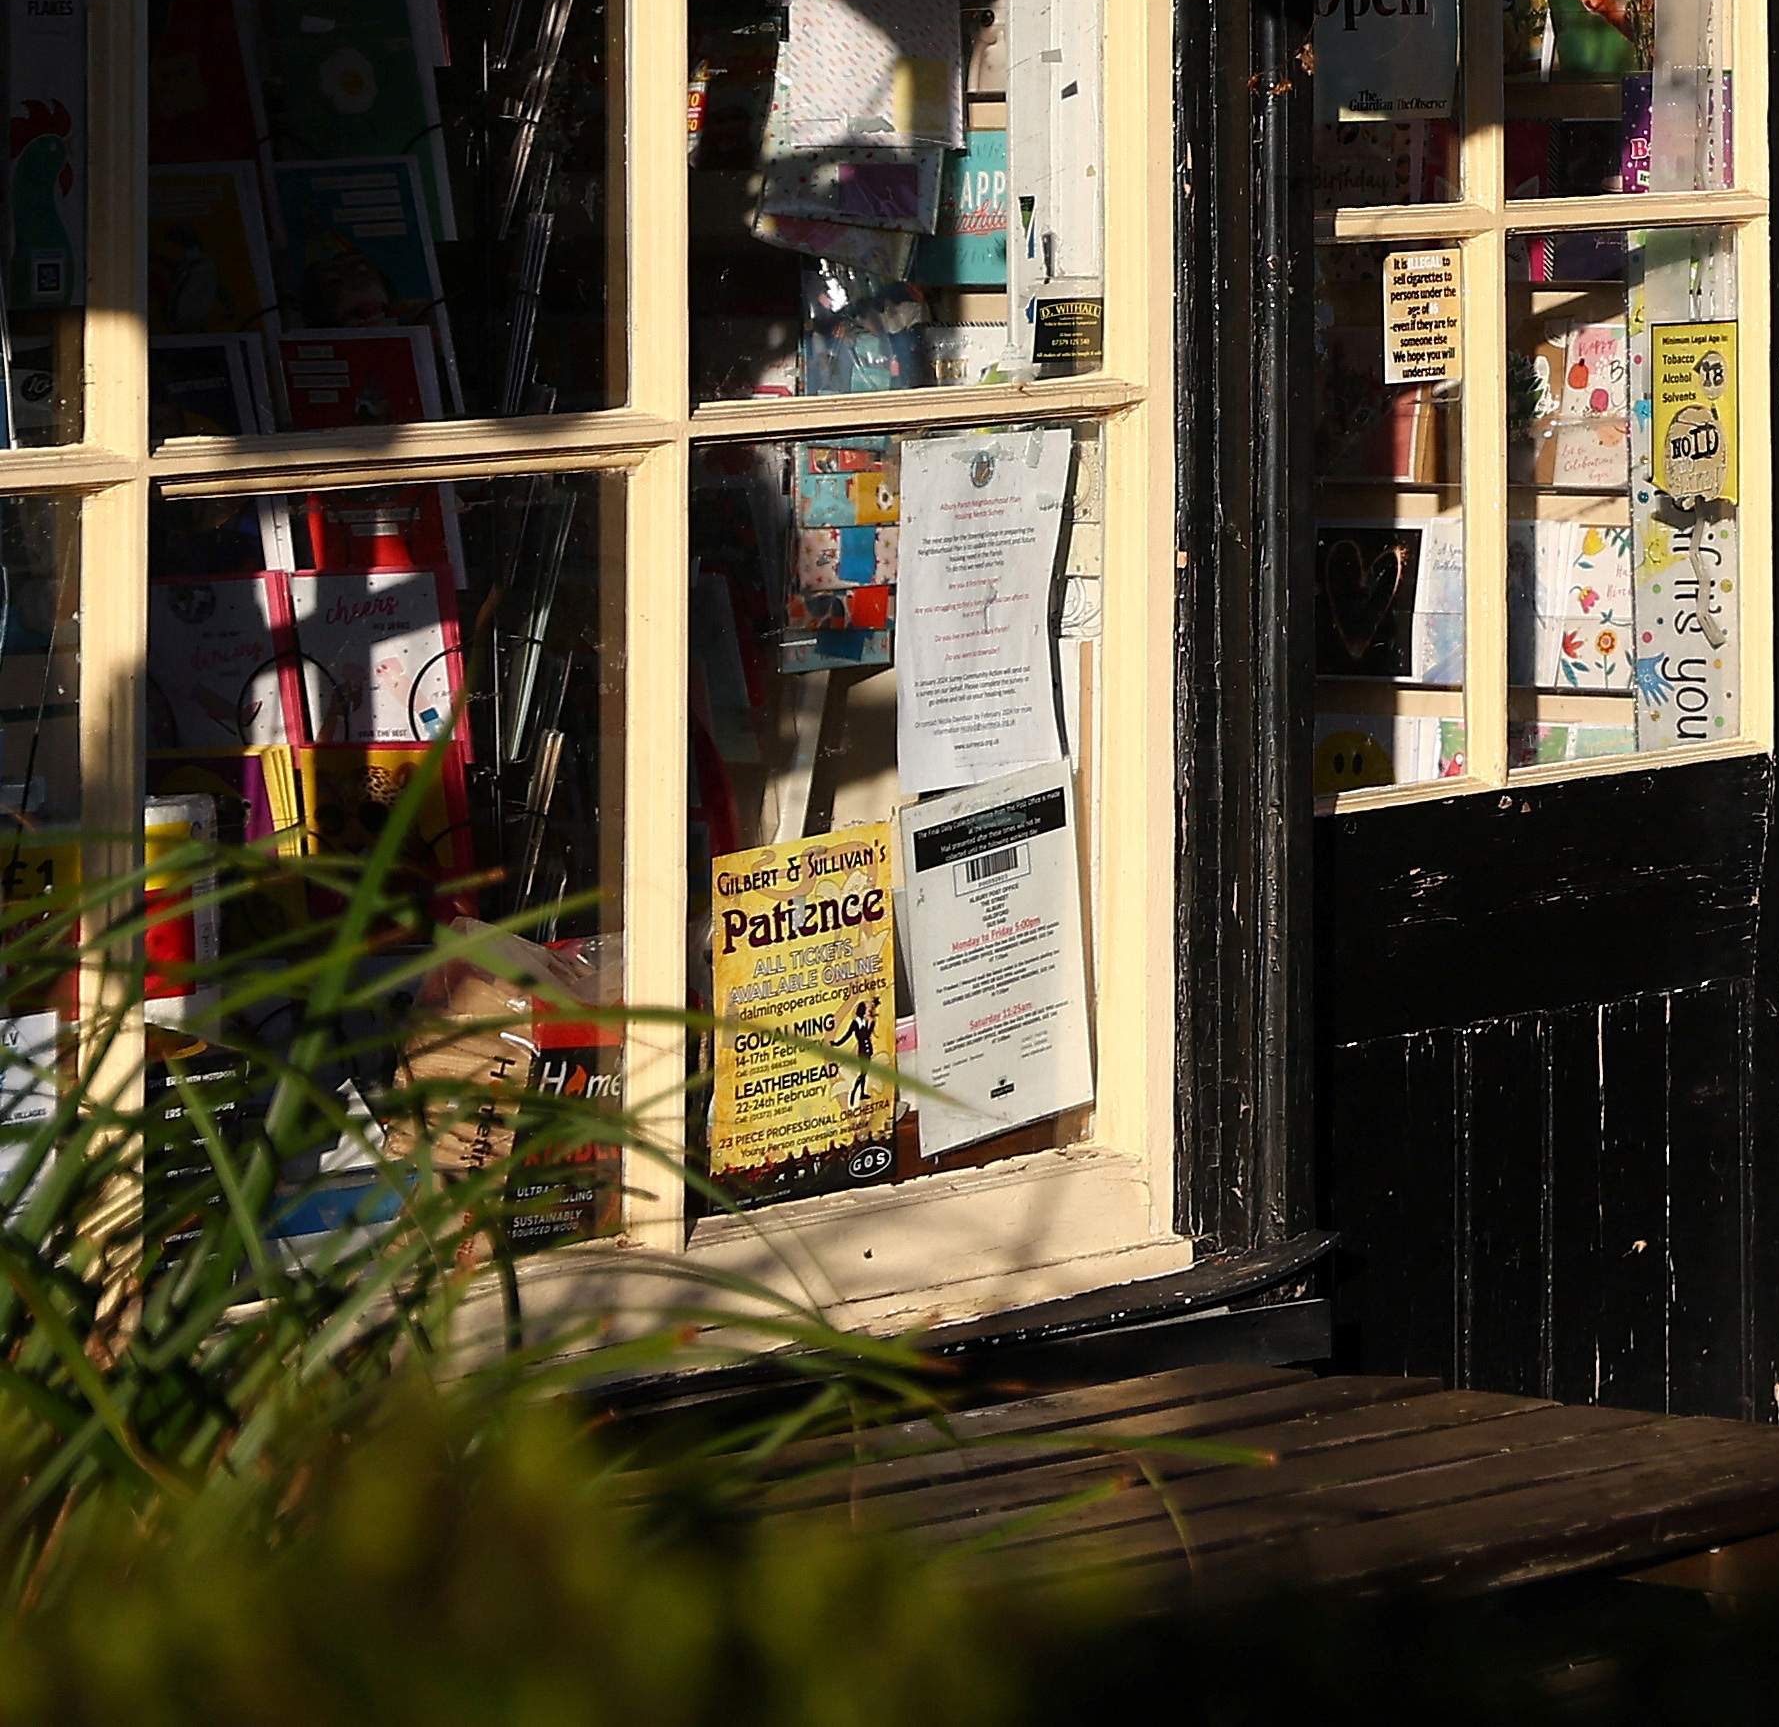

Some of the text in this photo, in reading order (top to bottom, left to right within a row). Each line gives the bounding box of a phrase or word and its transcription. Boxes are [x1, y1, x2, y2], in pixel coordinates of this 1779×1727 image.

[28, 1, 73, 16] FLAKES
[1358, 90, 1377, 102] The
[1349, 99, 1393, 112] Guardian
[1394, 256, 1450, 270] It is ILLEGAL to
[1393, 271, 1452, 287] sell cigarettes to
[1390, 286, 1456, 304] persons under the
[1407, 306, 1420, 319] age
[1422, 303, 1429, 315] of
[1416, 319, 1432, 333] they
[1434, 320, 1446, 330] are
[1446, 316, 1457, 329] for
[1400, 334, 1448, 348] someone else
[1662, 336, 1690, 346] Minimum
[1691, 335, 1707, 345] Legal
[1708, 334, 1721, 344] Age
[1393, 347, 1456, 365] We hope you will
[1662, 354, 1695, 365] Tobacco
[1402, 363, 1446, 379] understand
[1662, 372, 1692, 385] Alcohol
[1702, 361, 1724, 387] 18
[1662, 391, 1696, 404] Solvents
[1660, 657, 1708, 739] you
[917, 830, 927, 840] The
[940, 822, 952, 834] Daily
[945, 848, 966, 862] collected
[987, 835, 1009, 850] following
[1009, 829, 1028, 843] working
[952, 836, 976, 851] presented
[717, 839, 886, 896] GILBERT & SULLIVAN'S
[722, 888, 885, 955] Patience
[951, 935, 979, 952] Monday
[981, 932, 989, 942] to
[990, 925, 1013, 940] Friday
[753, 938, 853, 979] ALL TICKETS
[730, 969, 817, 1006] AVAILABLE
[970, 1014, 1000, 1031] Saturday
[735, 1049, 769, 1069] 14-17th
[773, 1039, 825, 1061] Februry
[735, 1063, 839, 1101] LEATHERHEAD
[735, 1096, 774, 1115] 22-24th
[776, 1084, 828, 1108] February
[719, 1136, 733, 1150] 23
[735, 1129, 764, 1147] PIECE
[765, 1114, 838, 1143] PROFESSIONAL
[839, 1098, 890, 1121] ORCHESTRA
[741, 1143, 768, 1158] Young
[769, 1135, 796, 1152] Person
[797, 1126, 838, 1145] concession
[512, 1209, 584, 1229] SUSTAINABLY
[511, 1224, 552, 1240] SOURCED
